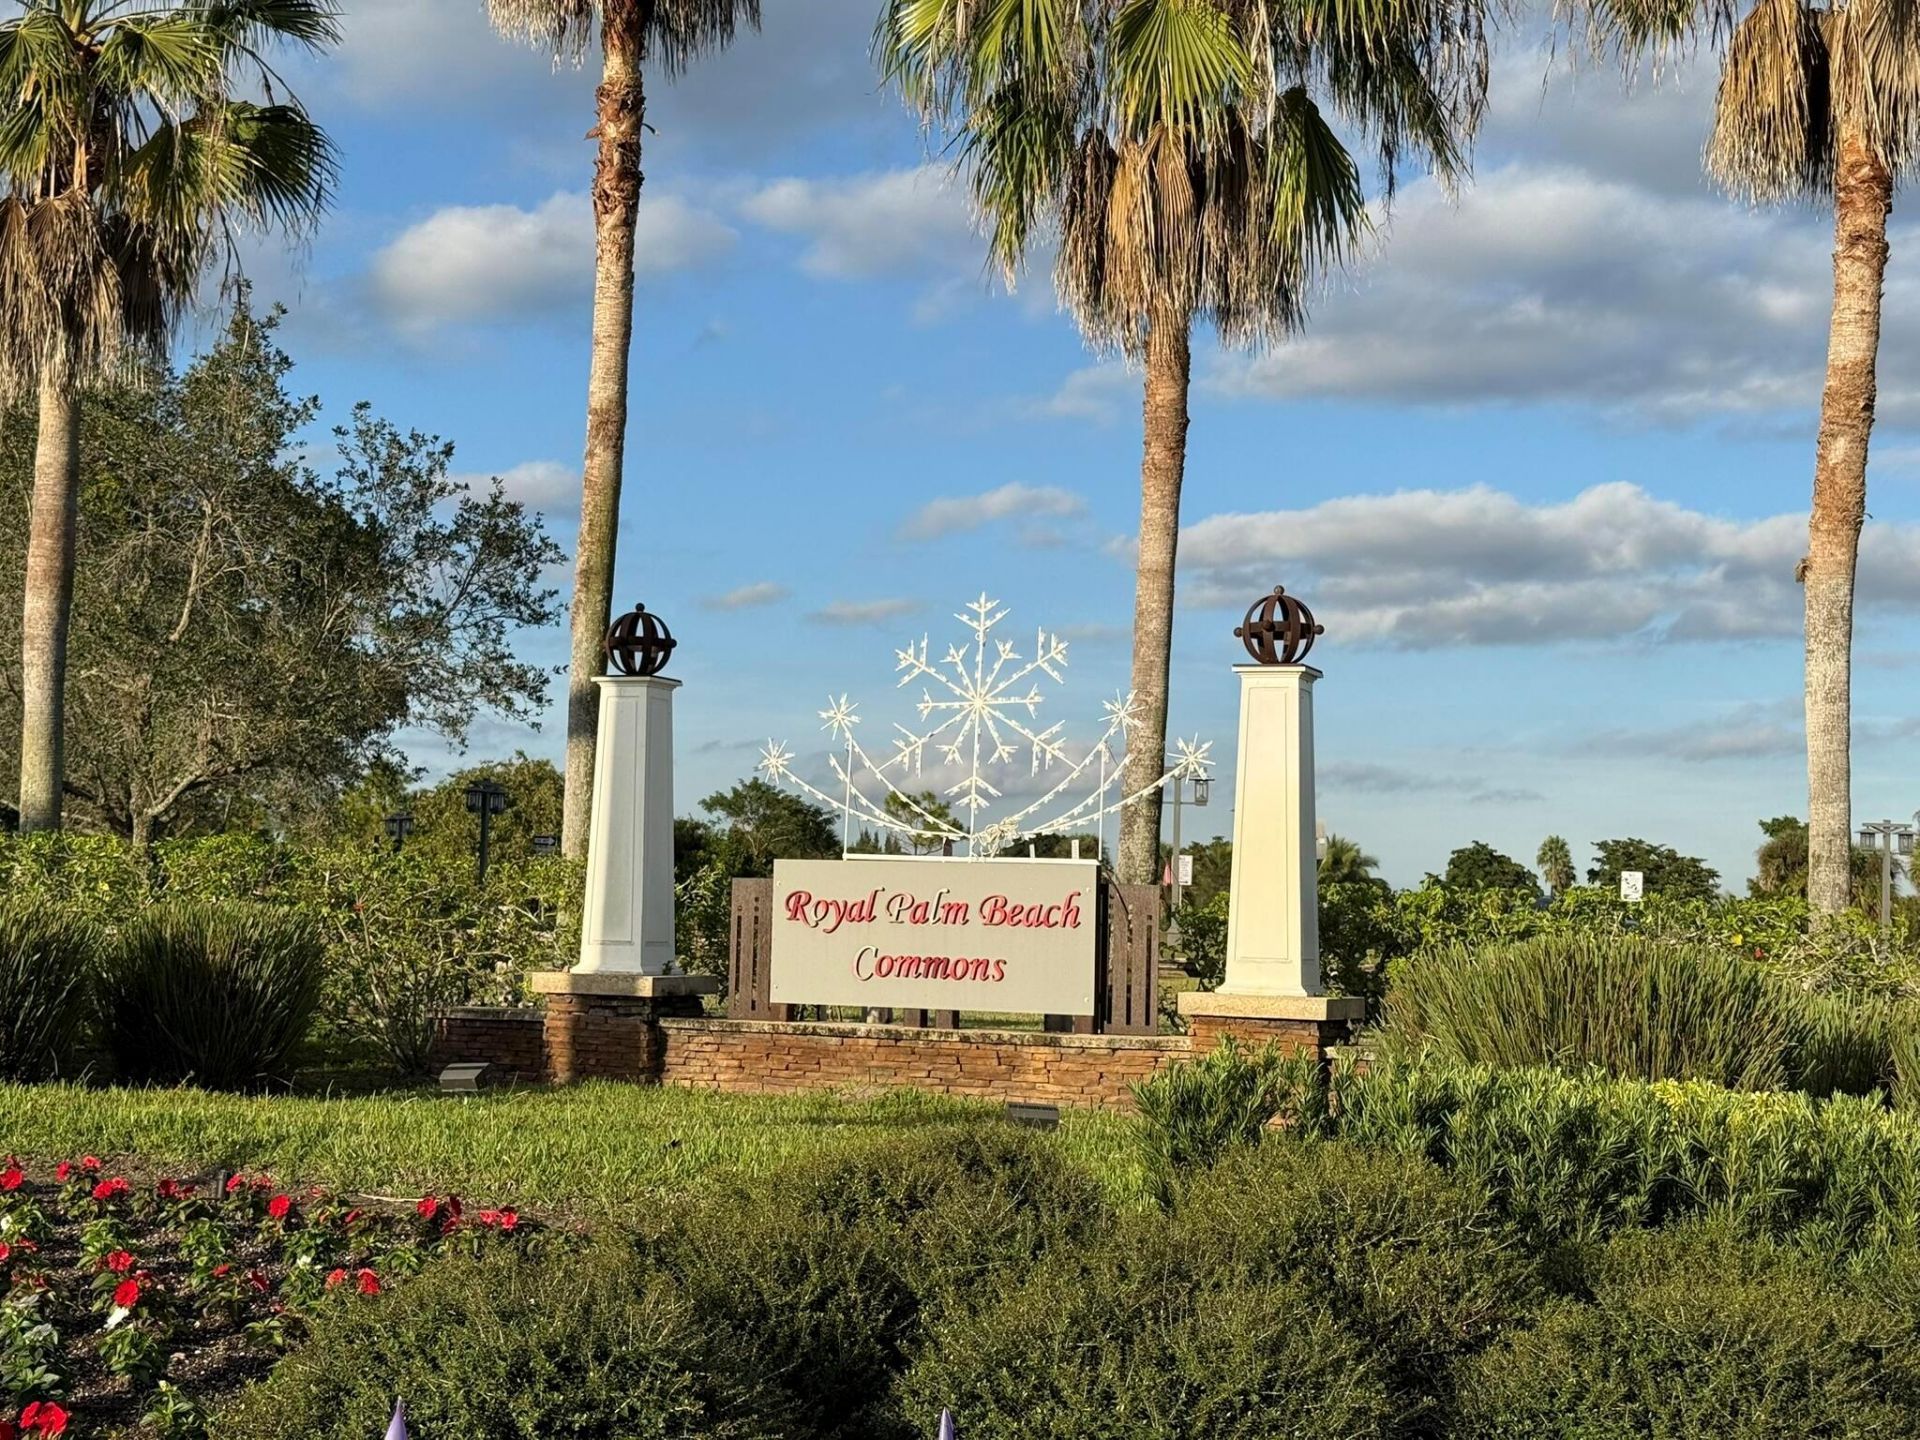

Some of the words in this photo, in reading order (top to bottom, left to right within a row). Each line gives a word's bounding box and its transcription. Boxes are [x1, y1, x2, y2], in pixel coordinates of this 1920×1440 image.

[784, 887, 885, 934] Royal
[886, 888, 970, 925] Palm
[980, 891, 1081, 929] Beach
[853, 945, 1008, 982] Commons
